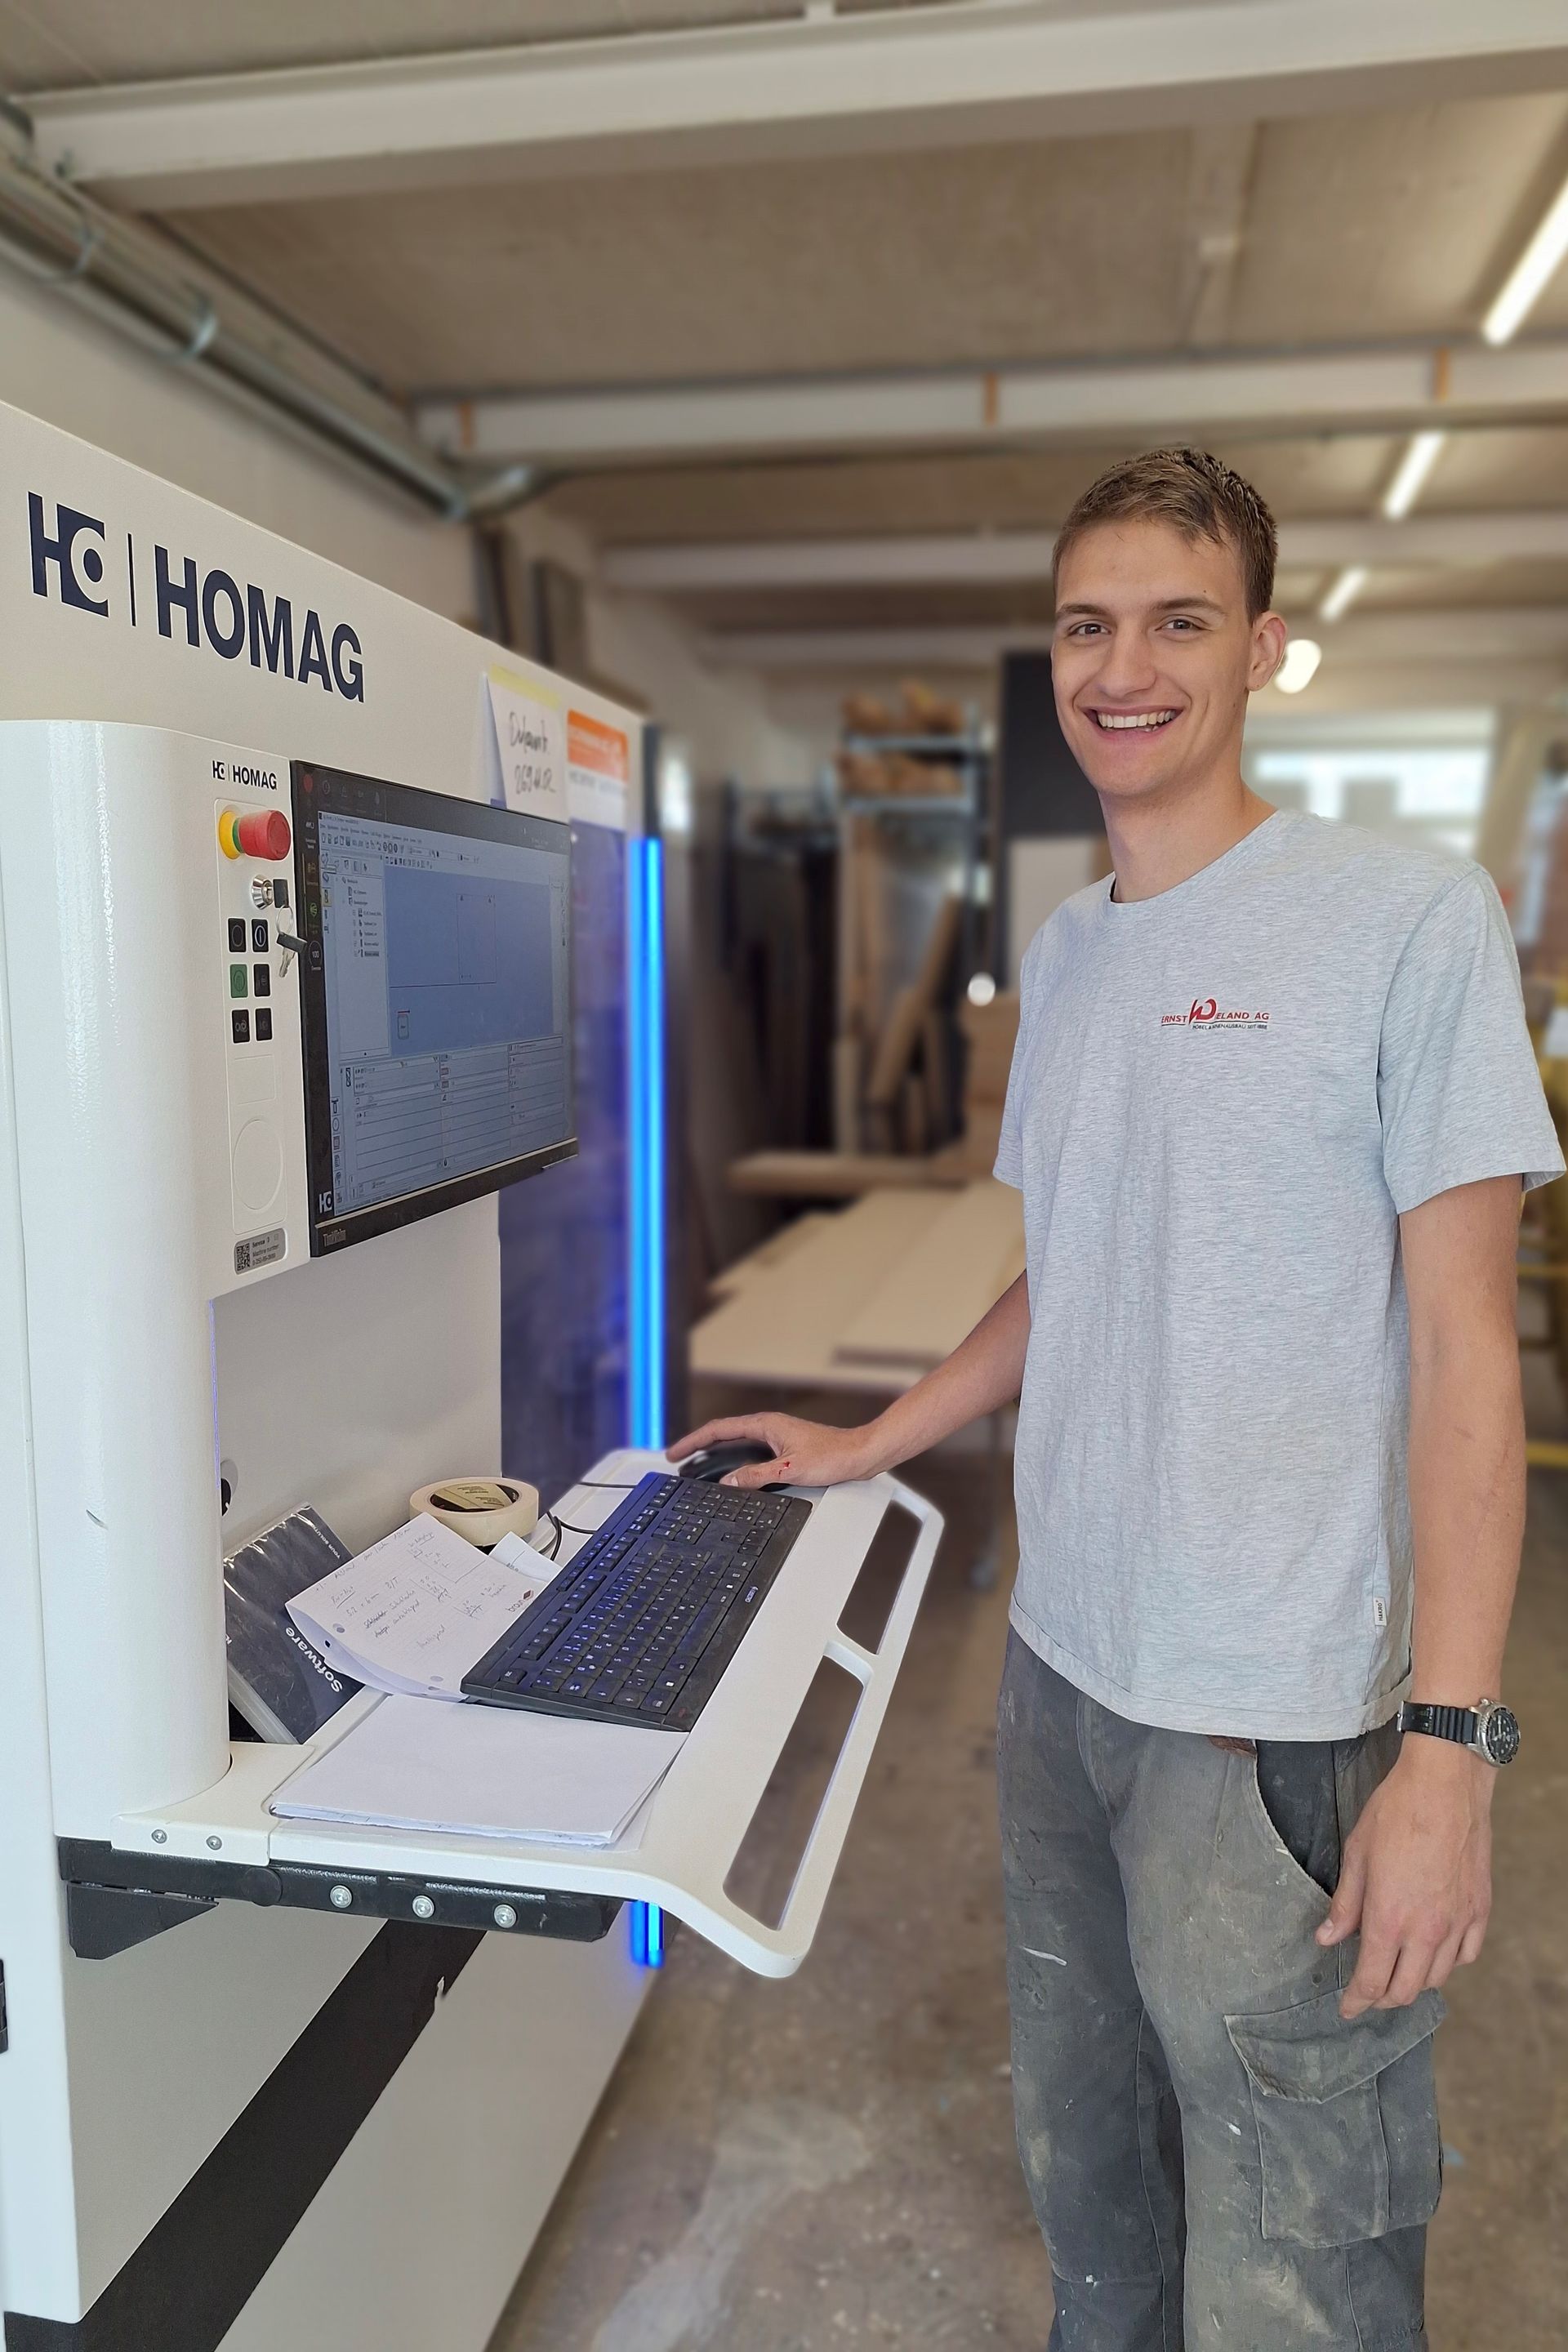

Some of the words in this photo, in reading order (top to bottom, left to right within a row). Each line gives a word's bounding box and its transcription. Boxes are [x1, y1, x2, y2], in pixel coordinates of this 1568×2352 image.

[154, 544, 364, 703] HOMAG
[233, 764, 277, 791] HOMAG
[1161, 1015, 1188, 1023] ERNST
[286, 1627, 343, 1693] Software
